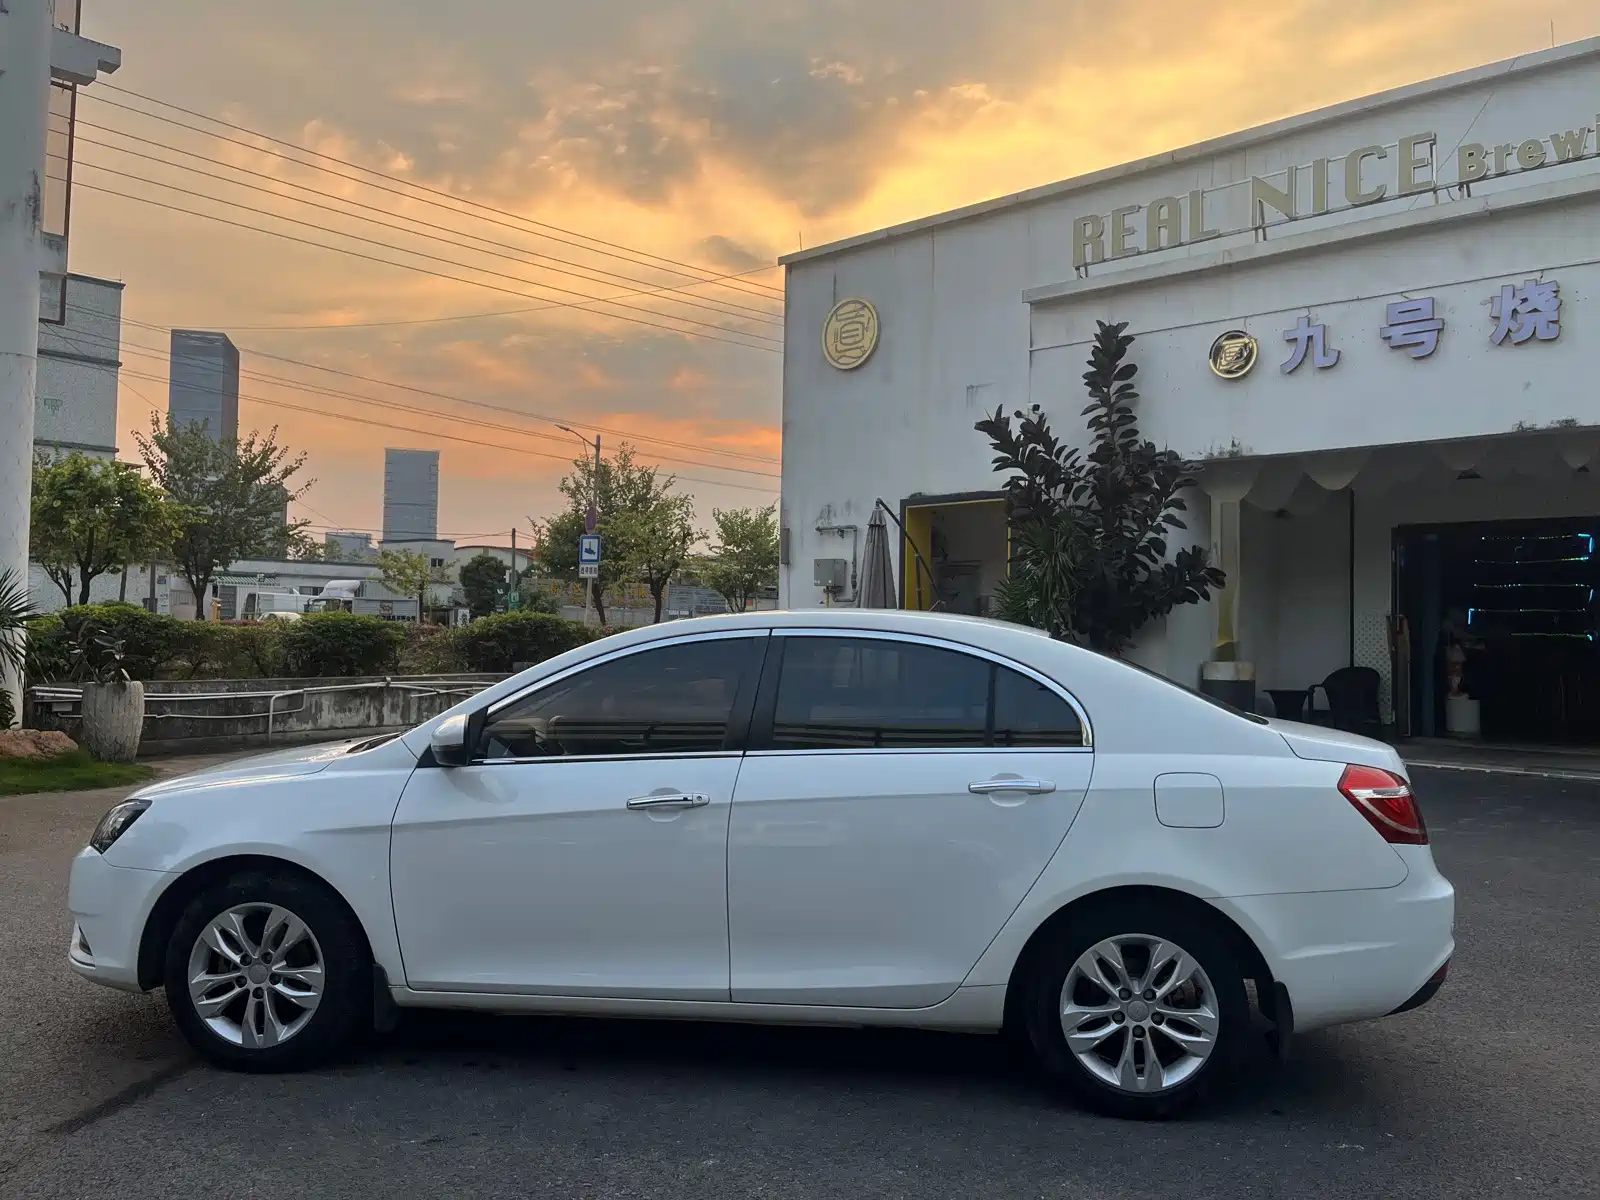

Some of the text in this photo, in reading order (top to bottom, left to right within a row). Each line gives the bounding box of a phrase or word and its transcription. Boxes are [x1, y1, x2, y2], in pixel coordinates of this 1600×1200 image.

[1073, 189, 1219, 267] REAL
[1251, 131, 1437, 227] NICE
[1280, 279, 1562, 375] 九号烧
